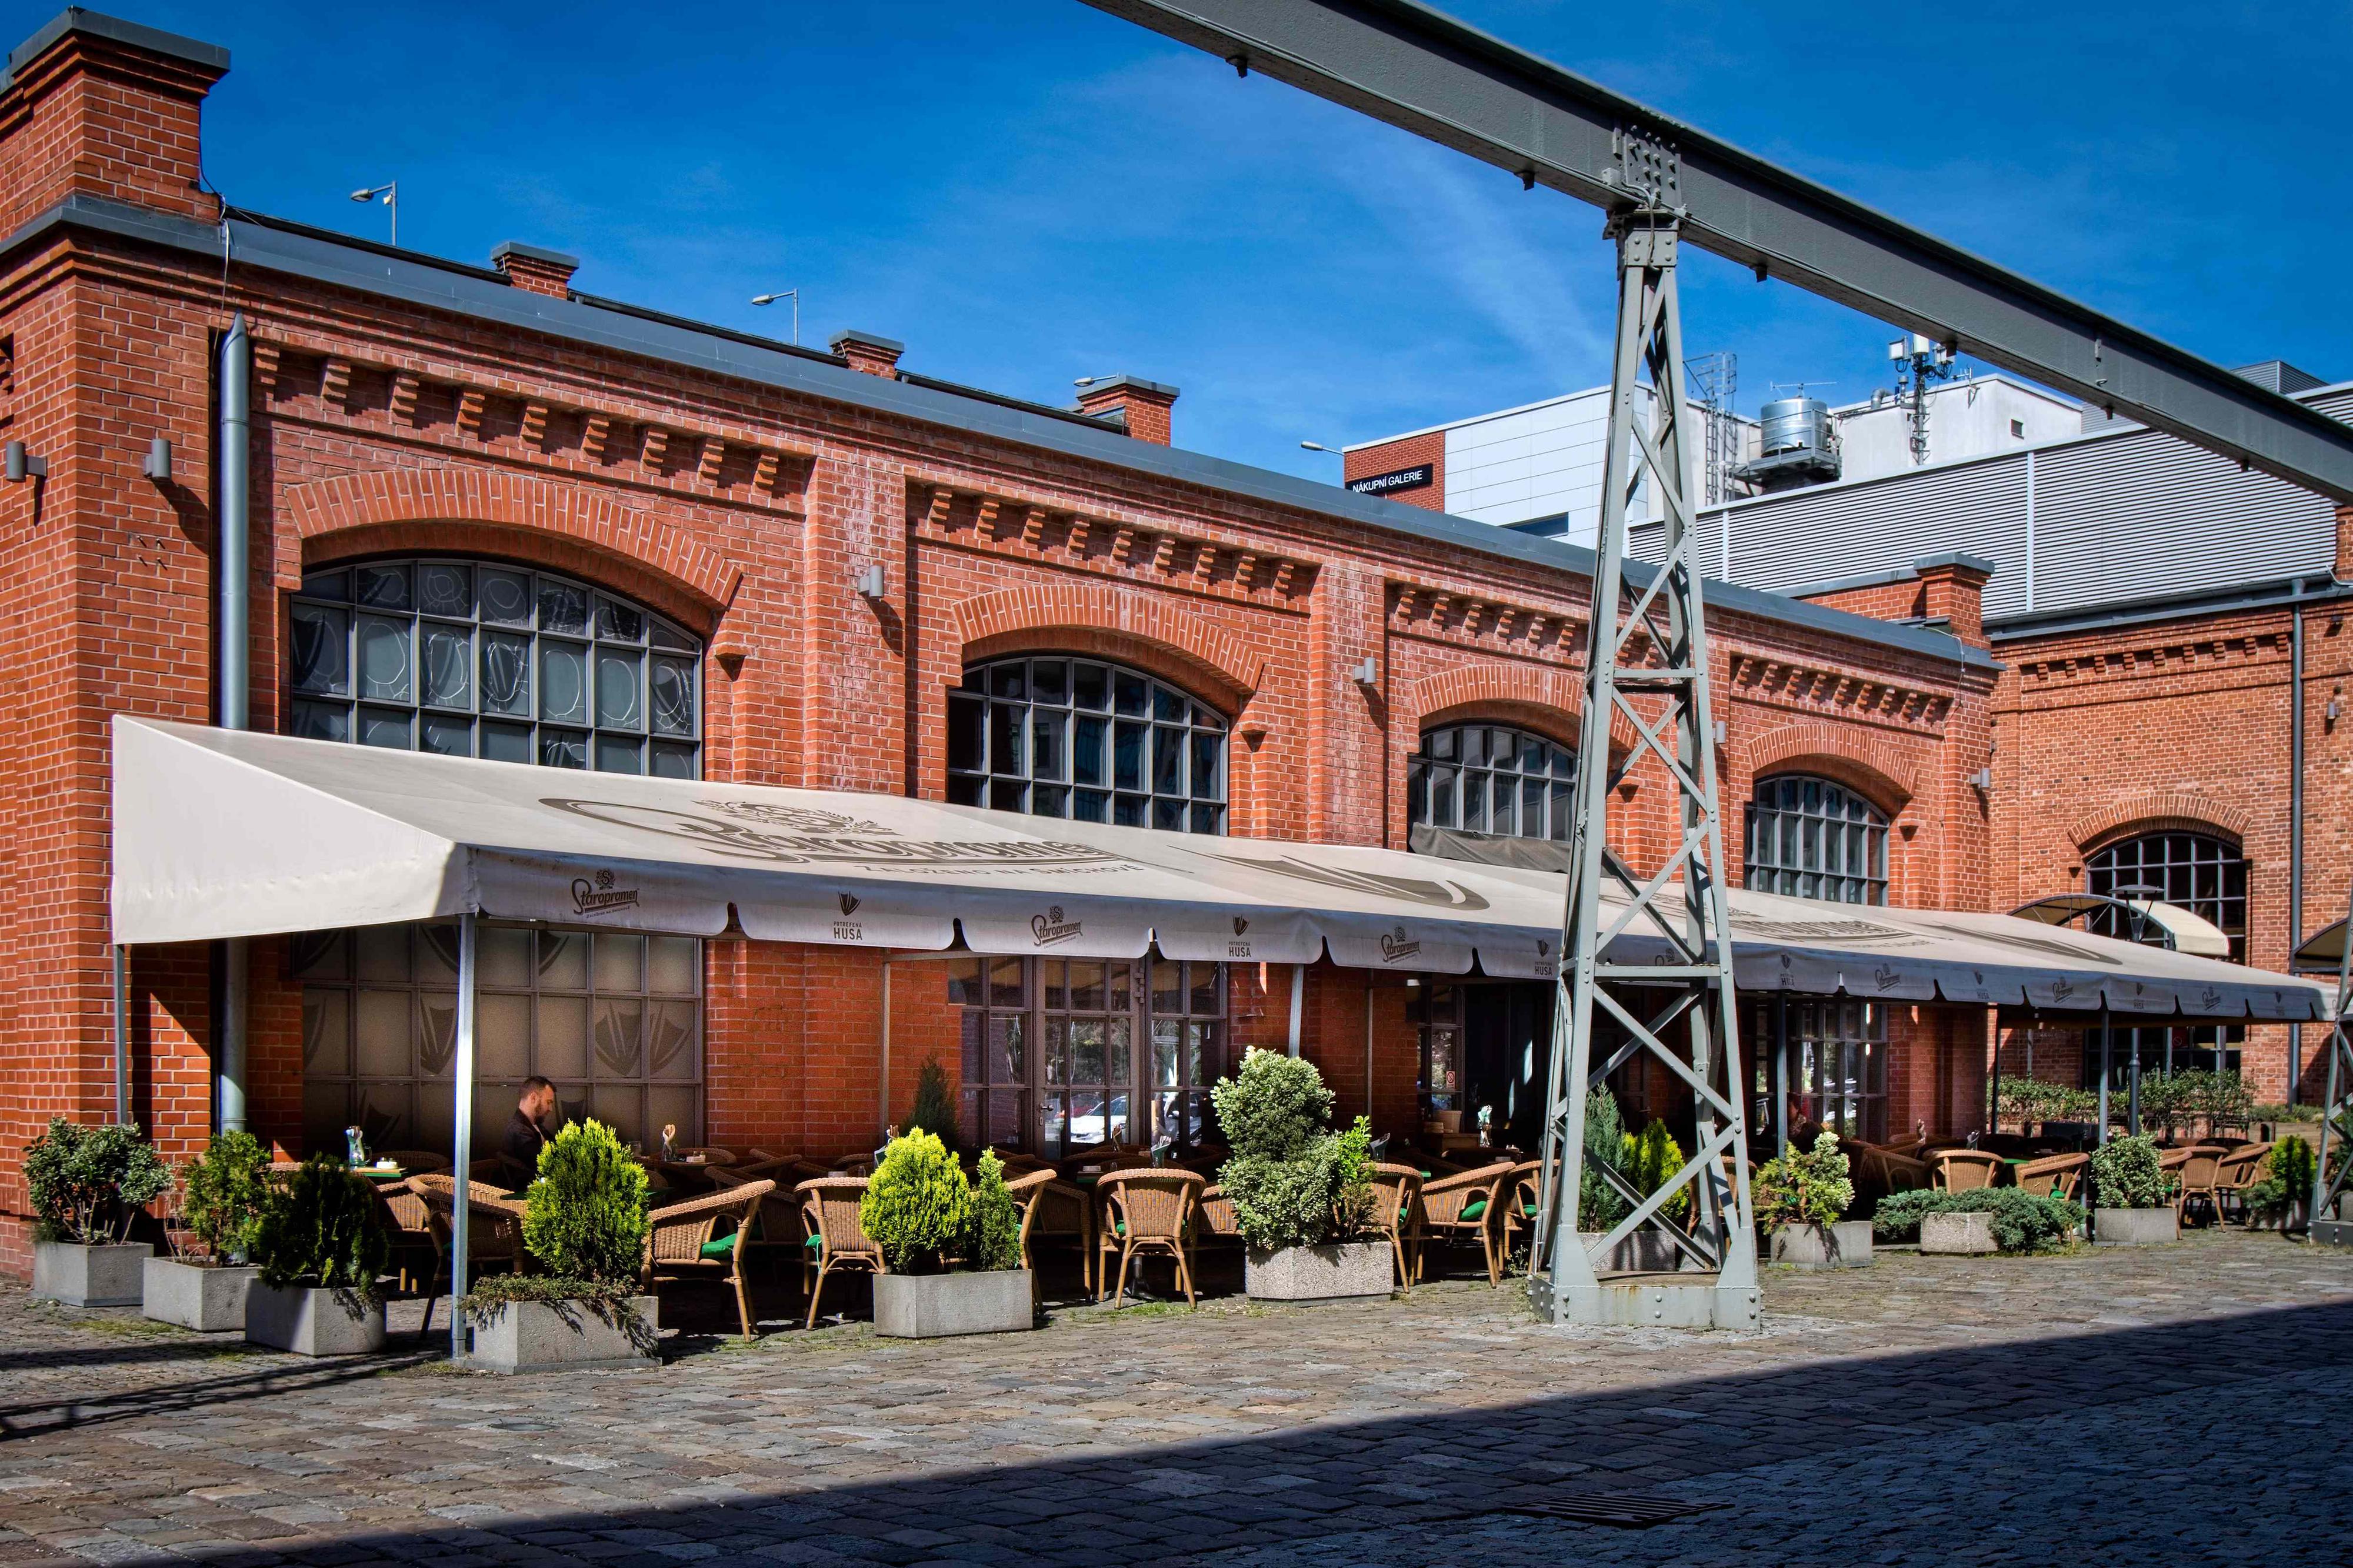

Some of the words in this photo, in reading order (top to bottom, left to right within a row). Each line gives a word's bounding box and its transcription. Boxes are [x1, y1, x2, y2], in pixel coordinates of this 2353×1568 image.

[1352, 476, 1387, 493] NÁKUPNÍ
[1388, 470, 1423, 486] GALERIE
[572, 878, 640, 916] Staropramen
[833, 928, 863, 940] HUSA
[1031, 915, 1083, 946] Staropramen
[1228, 946, 1251, 958] HUSA
[1381, 934, 1421, 962] Staropramen
[1535, 966, 1553, 976] HUSA
